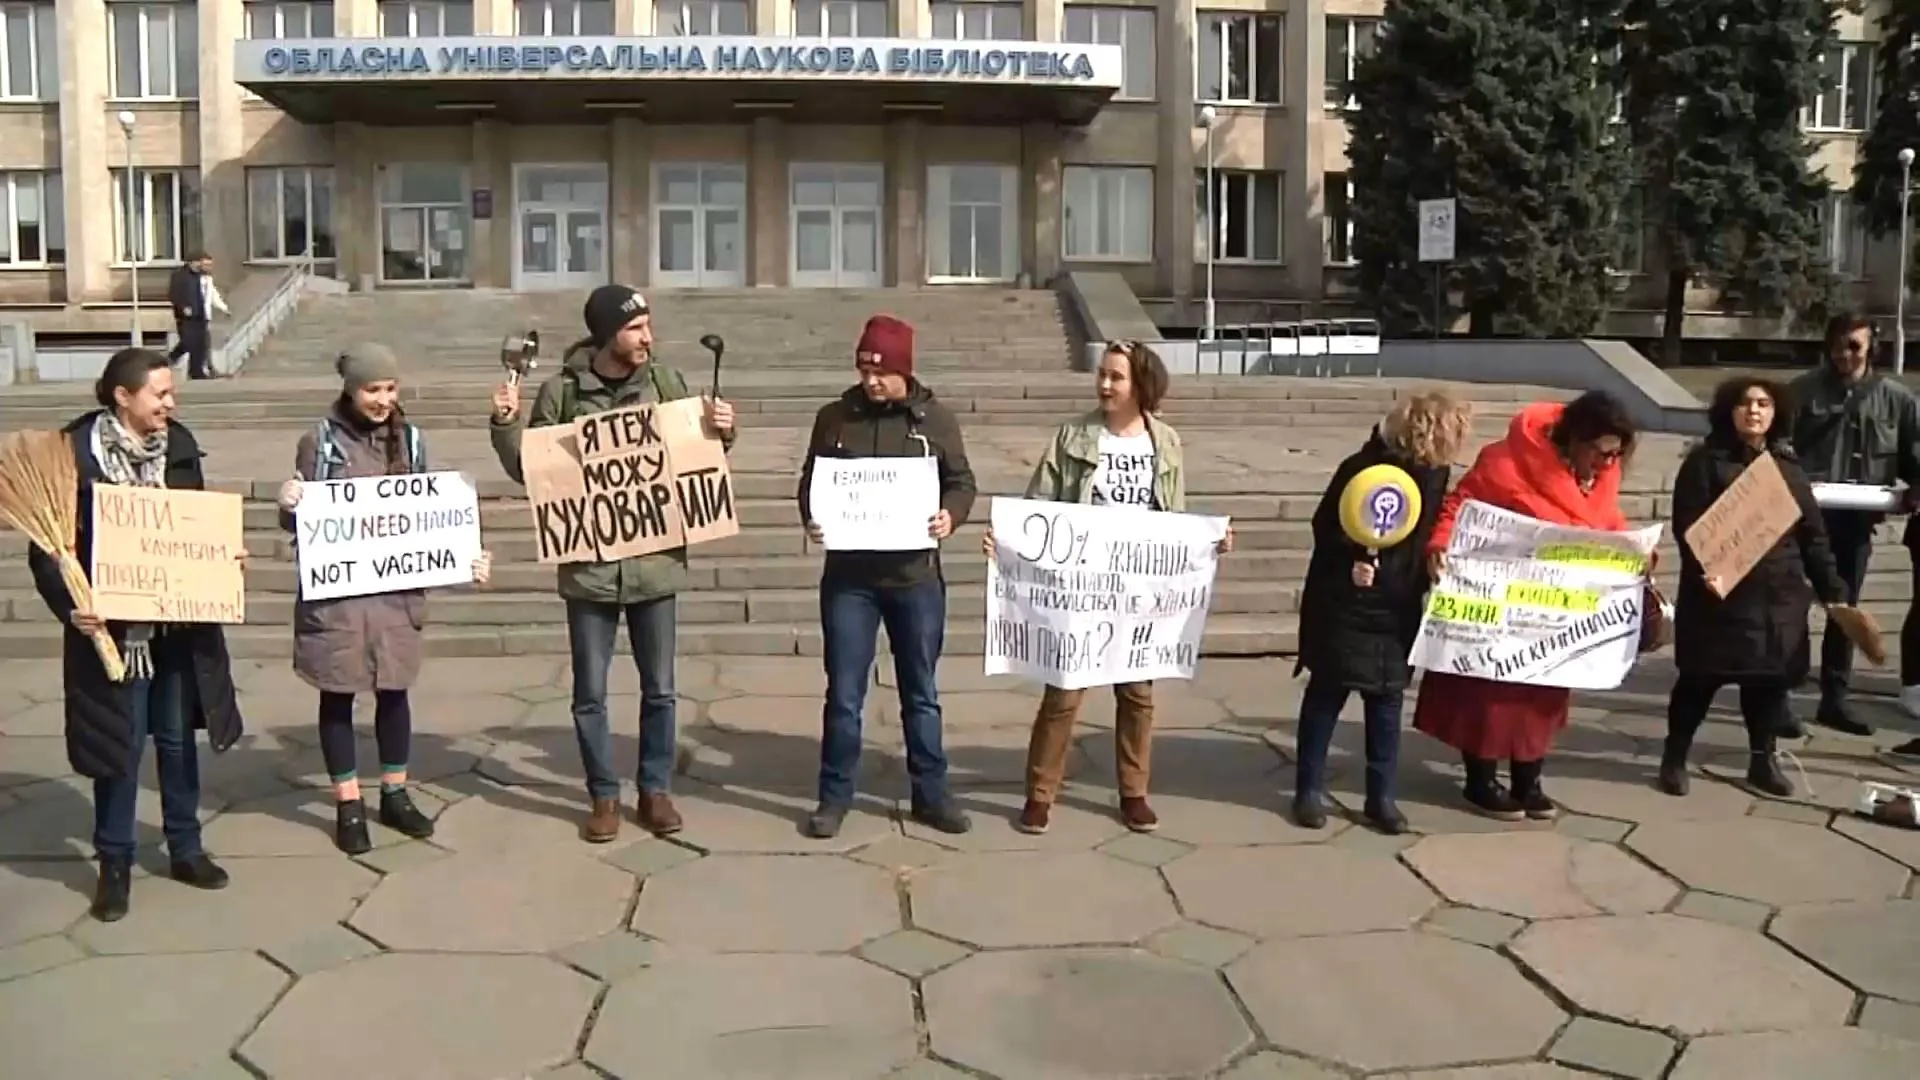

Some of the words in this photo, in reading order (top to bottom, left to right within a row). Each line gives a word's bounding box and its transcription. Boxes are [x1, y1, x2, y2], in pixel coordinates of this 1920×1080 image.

[264, 47, 430, 75] ОБЛАСНА
[440, 45, 707, 73] УНІВЕРСАЛЬНА
[718, 45, 880, 74] НАУКОВА
[886, 47, 1095, 79] БІБЛІОТЕКА
[582, 419, 600, 454] Я
[600, 408, 662, 449] ТЕЖ
[325, 482, 356, 503] TO
[377, 476, 439, 498] COOK
[583, 450, 664, 494] МОЖУ
[99, 491, 174, 532] КВІТИ
[1111, 485, 1151, 505] GIR
[304, 514, 355, 546] YOU
[360, 513, 411, 540] NEED
[416, 507, 475, 532] HANDS
[97, 562, 168, 592] ПРАВА
[311, 561, 357, 588] NOT
[372, 549, 457, 579] VAGINA
